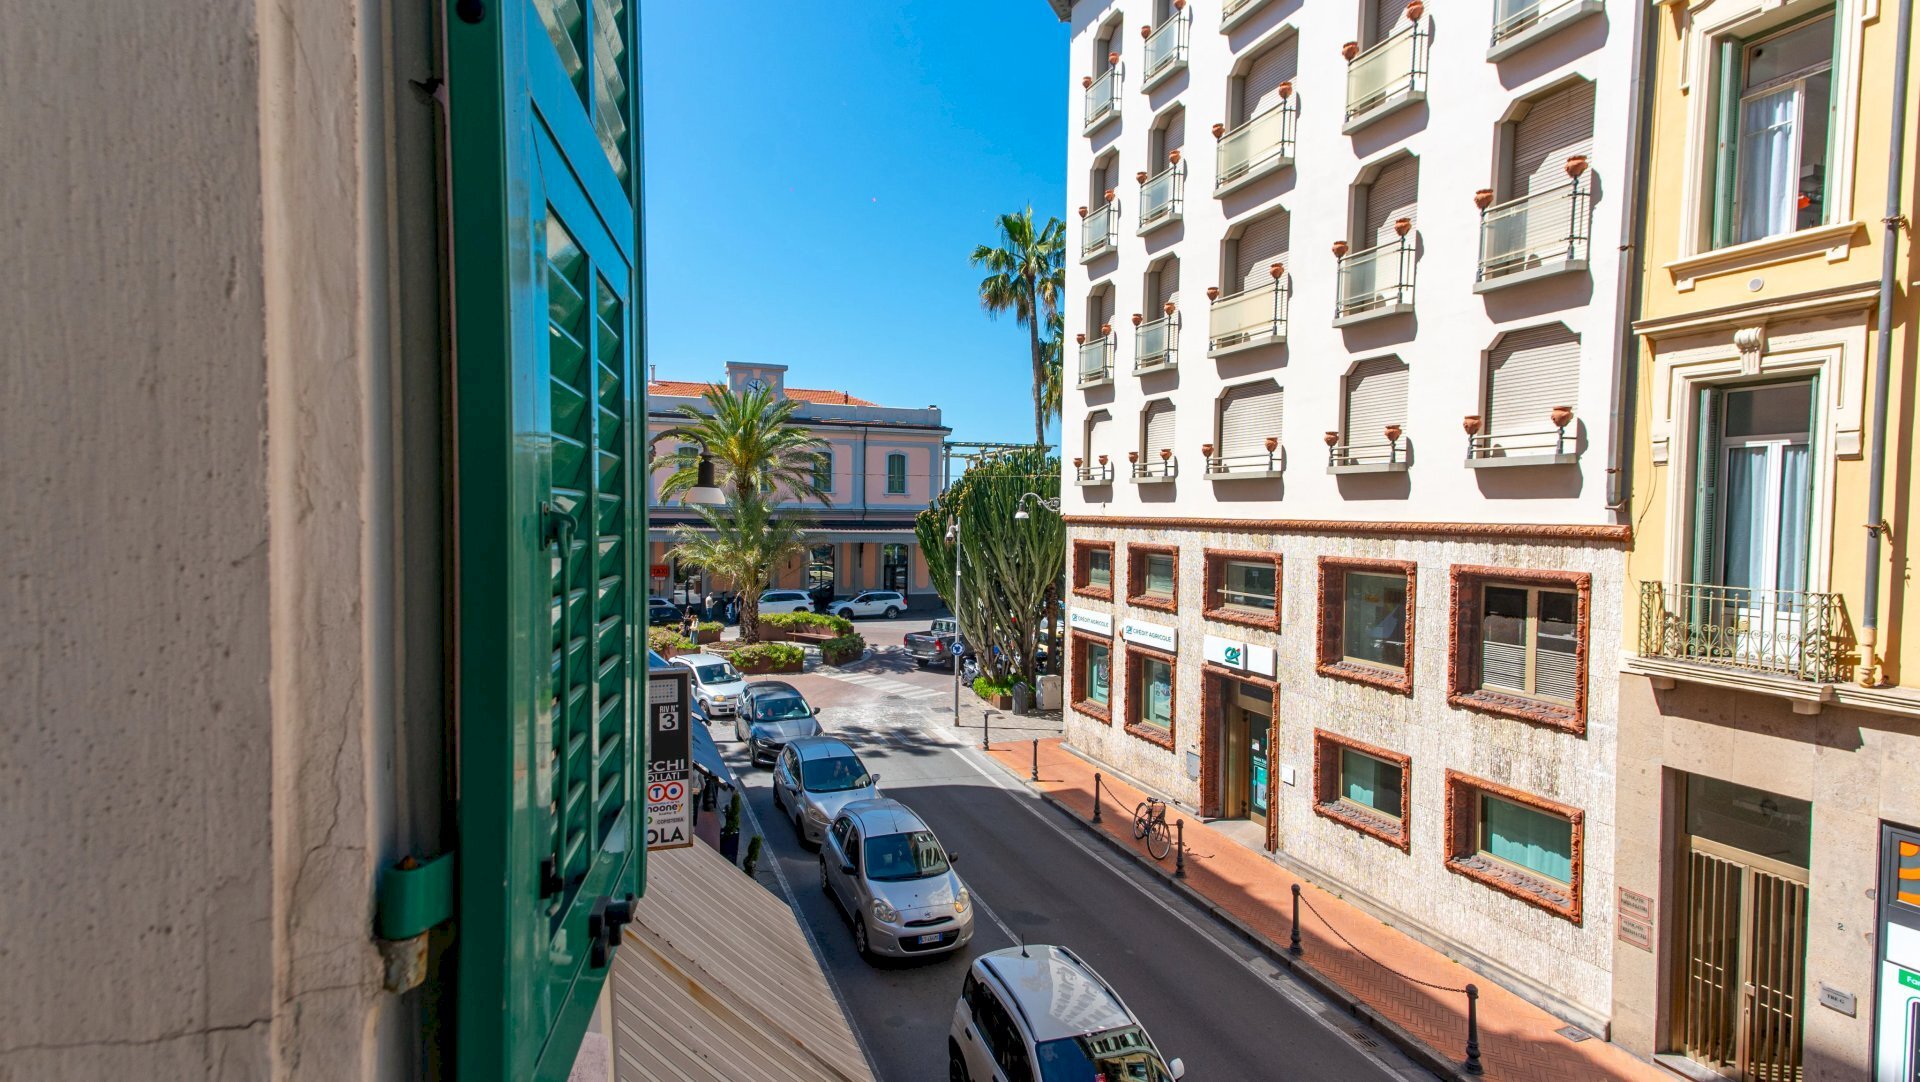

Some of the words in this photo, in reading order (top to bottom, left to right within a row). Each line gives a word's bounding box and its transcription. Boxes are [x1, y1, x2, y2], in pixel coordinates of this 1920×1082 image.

[1149, 632, 1172, 642] AGRICOLE
[659, 705, 670, 713] RIV
[662, 713, 676, 730] 3
